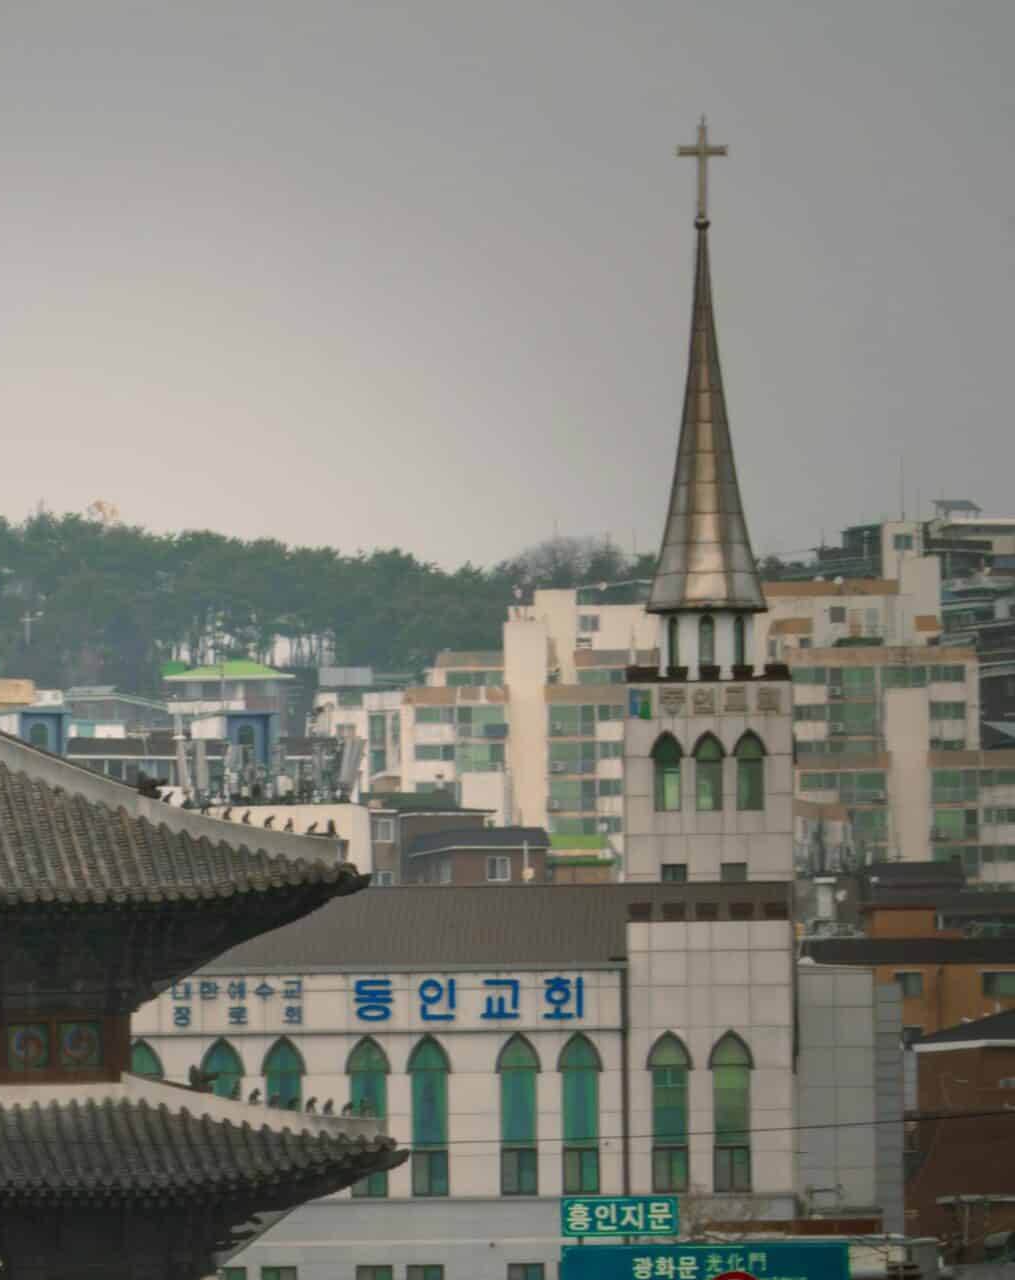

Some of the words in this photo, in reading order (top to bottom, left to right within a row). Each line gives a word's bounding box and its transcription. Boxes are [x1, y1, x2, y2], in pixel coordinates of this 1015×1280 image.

[353, 977, 585, 1022] 동인교회
[566, 1202, 673, 1232] 흥인지문
[632, 1256, 700, 1280] 광화문
